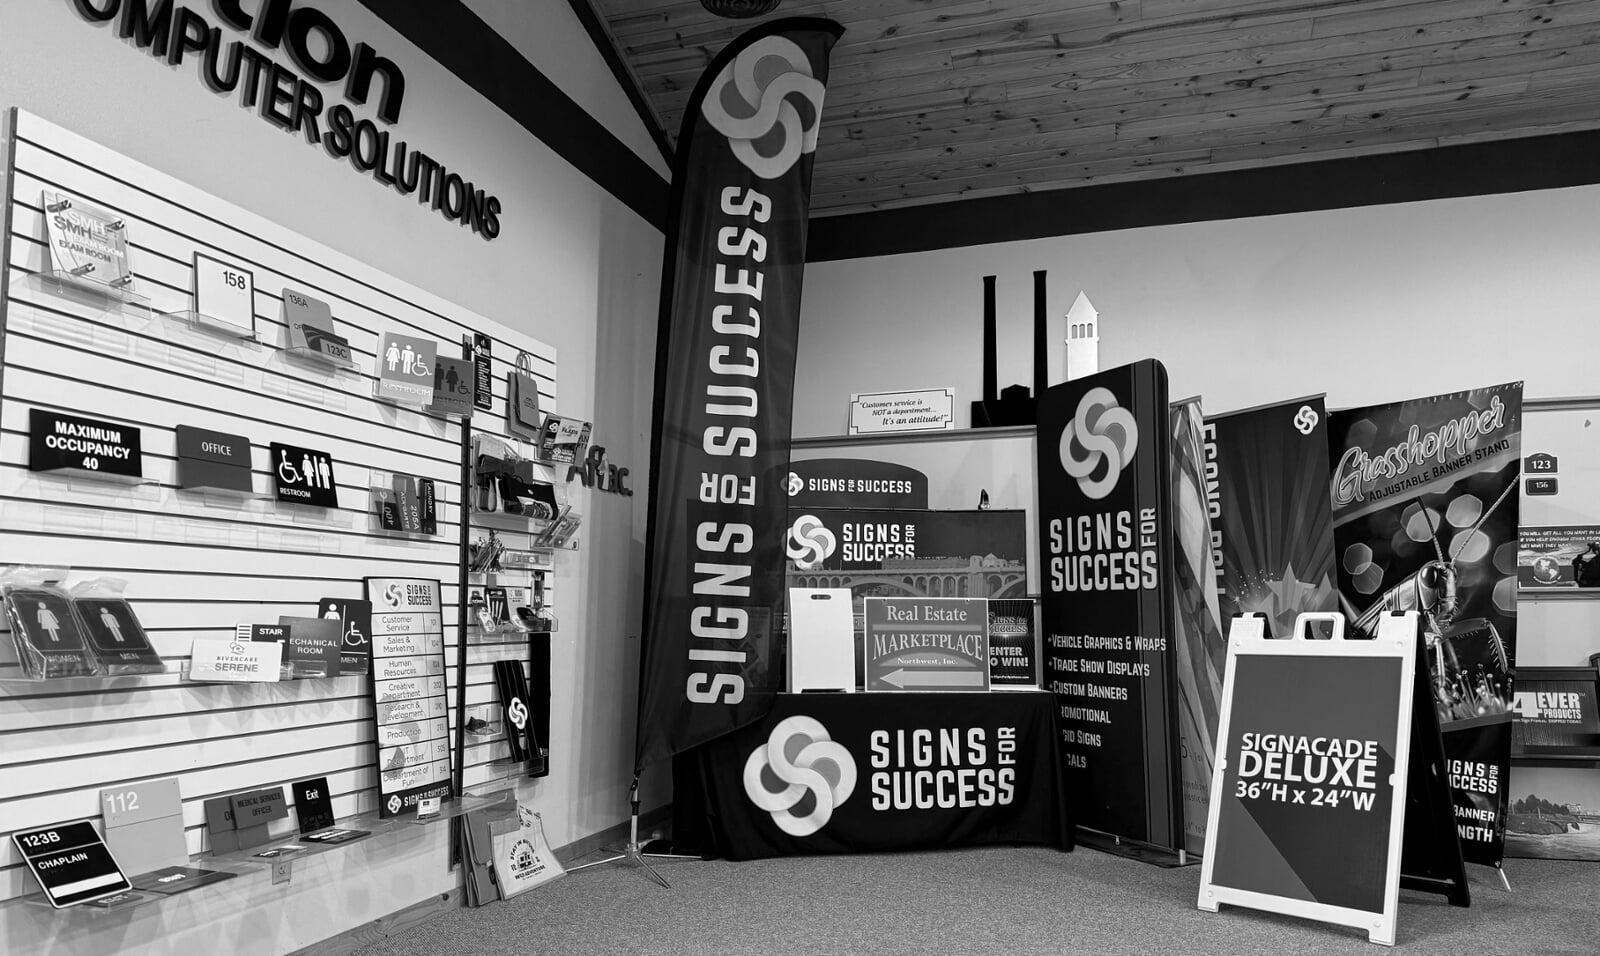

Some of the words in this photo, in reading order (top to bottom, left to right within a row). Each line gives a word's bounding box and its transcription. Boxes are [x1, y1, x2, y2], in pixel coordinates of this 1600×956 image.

[324, 104, 502, 240] SOLUTIONS
[59, 239, 85, 254] EXAM
[85, 247, 112, 264] ROOM
[223, 270, 246, 290] 158
[702, 185, 772, 458] SUCCESS
[326, 343, 348, 359] 123C
[893, 399, 916, 407] service
[917, 398, 923, 406] is
[872, 408, 887, 417] NOT
[55, 420, 121, 444] MAXIMUM
[46, 435, 130, 459] OCCUPANCY
[201, 441, 232, 456] OFFICE
[1333, 394, 1506, 505] Grasshopper
[83, 457, 98, 470] 40
[1369, 471, 1430, 502] ADJUSTABLE
[1432, 454, 1472, 477] BANNER
[1475, 438, 1510, 461] STAND
[1531, 460, 1551, 470] 123
[279, 487, 311, 498] RESTROOM
[699, 472, 756, 505] FOR
[809, 478, 846, 492] SIGNS
[848, 479, 856, 492] FOR
[857, 480, 912, 494] SUCCESS
[843, 523, 900, 543] SIGNS
[905, 524, 916, 543] FOR
[1049, 510, 1132, 554] SIGNS
[1140, 507, 1157, 547] FOR
[843, 543, 916, 562] SUCCESS
[1050, 550, 1158, 592] SUCCESS
[407, 584, 427, 596] SIGNS
[407, 595, 432, 606] SUCCESS
[382, 616, 413, 624] Customer
[686, 521, 754, 705] SIGNS
[887, 605, 918, 621] Real
[924, 605, 967, 622] Estate
[259, 627, 283, 636] STAIR
[387, 636, 405, 644] Sales
[289, 637, 338, 647] ECHANICAL
[383, 644, 415, 653] Marketing
[872, 633, 983, 662] MARKETPLACE
[1051, 633, 1083, 649] VEHICLE
[1084, 634, 1123, 650] GRAPHICS
[1125, 635, 1132, 651] &
[1134, 636, 1167, 651] WRAPS
[297, 647, 323, 655] ROOM
[990, 646, 1023, 656] ENTER
[214, 663, 258, 673] SERENE
[340, 656, 358, 664] MEN
[388, 659, 412, 667] Human
[943, 657, 958, 665] Inc.
[990, 657, 999, 667] O
[1001, 656, 1029, 667] WIN!
[1052, 656, 1078, 672] TRADE
[1080, 659, 1105, 674] SHOW
[1107, 660, 1150, 677] DISPLAYS
[1053, 680, 1085, 696] CUSTOM
[1087, 683, 1128, 701] BANNERS
[1061, 705, 1112, 724] OMOTIONAL
[1543, 708, 1582, 719] PRODUCTS
[387, 728, 421, 739] Production
[1077, 729, 1102, 747] SIGNS
[870, 727, 987, 768] SIGNS
[998, 726, 1016, 765] FOR
[1241, 732, 1378, 760] SIGNACADE
[1238, 750, 1377, 789] DELUXE
[1447, 759, 1485, 777] IGNS
[1489, 764, 1499, 780] FOR
[402, 779, 415, 787] Fun
[871, 767, 1016, 811] SUCCESS
[1448, 773, 1498, 794] CCESS
[106, 791, 139, 813] 112
[305, 789, 320, 801] Exit
[1292, 789, 1306, 804] x
[22, 831, 61, 848] 123B
[1457, 824, 1493, 843] NGTH
[38, 852, 88, 870] CHAPLAIN
